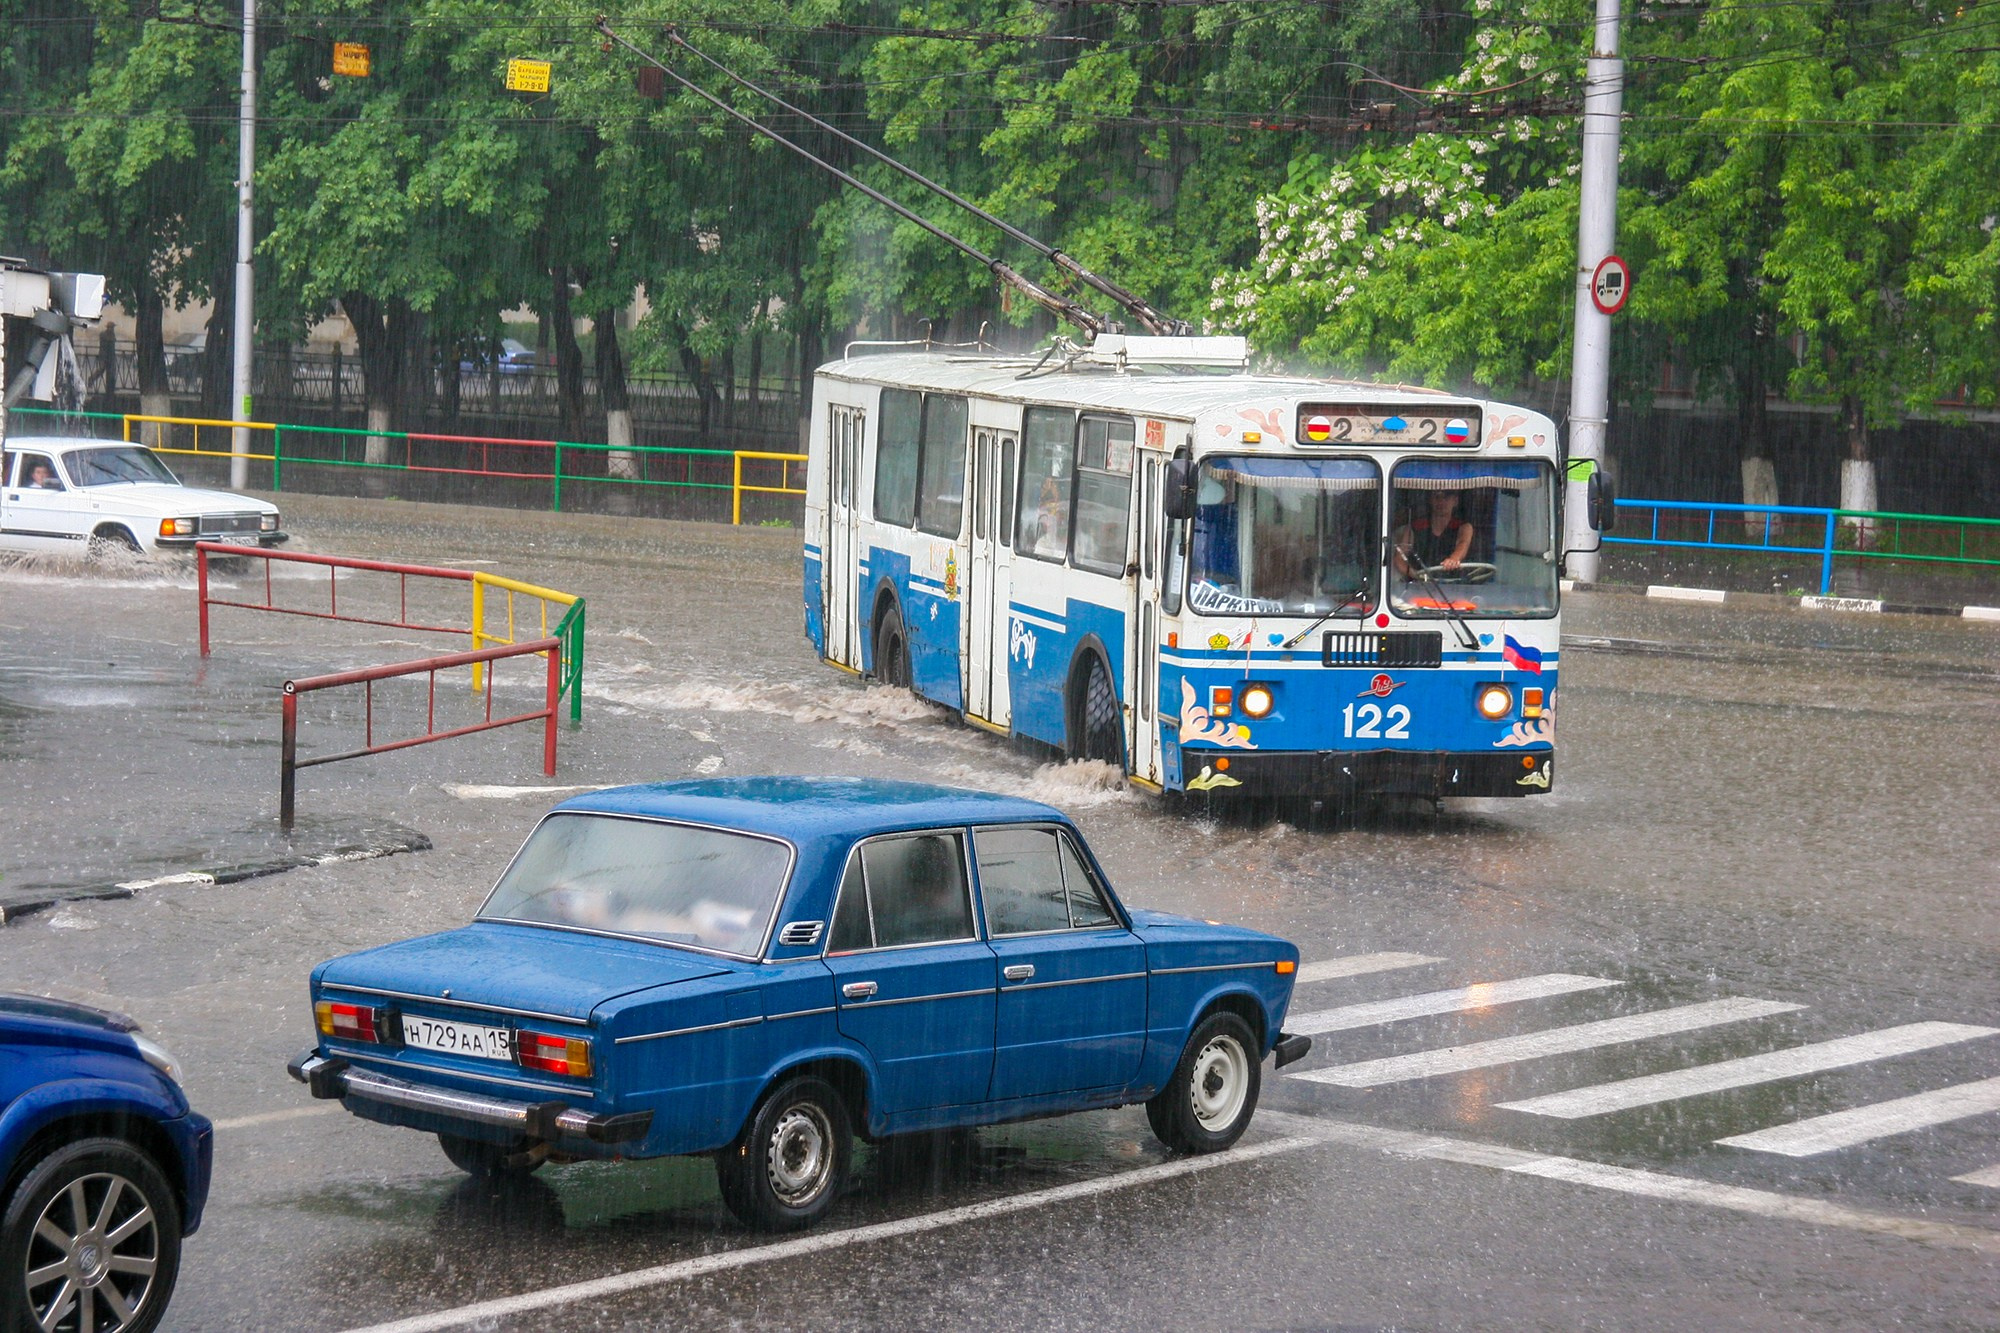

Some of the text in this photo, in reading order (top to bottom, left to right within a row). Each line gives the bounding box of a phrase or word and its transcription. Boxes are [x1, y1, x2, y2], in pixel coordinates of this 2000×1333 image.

[1333, 417, 1352, 442] 2
[1419, 418, 1438, 443] 2
[1342, 702, 1411, 739] 122
[488, 1031, 509, 1049] 15
